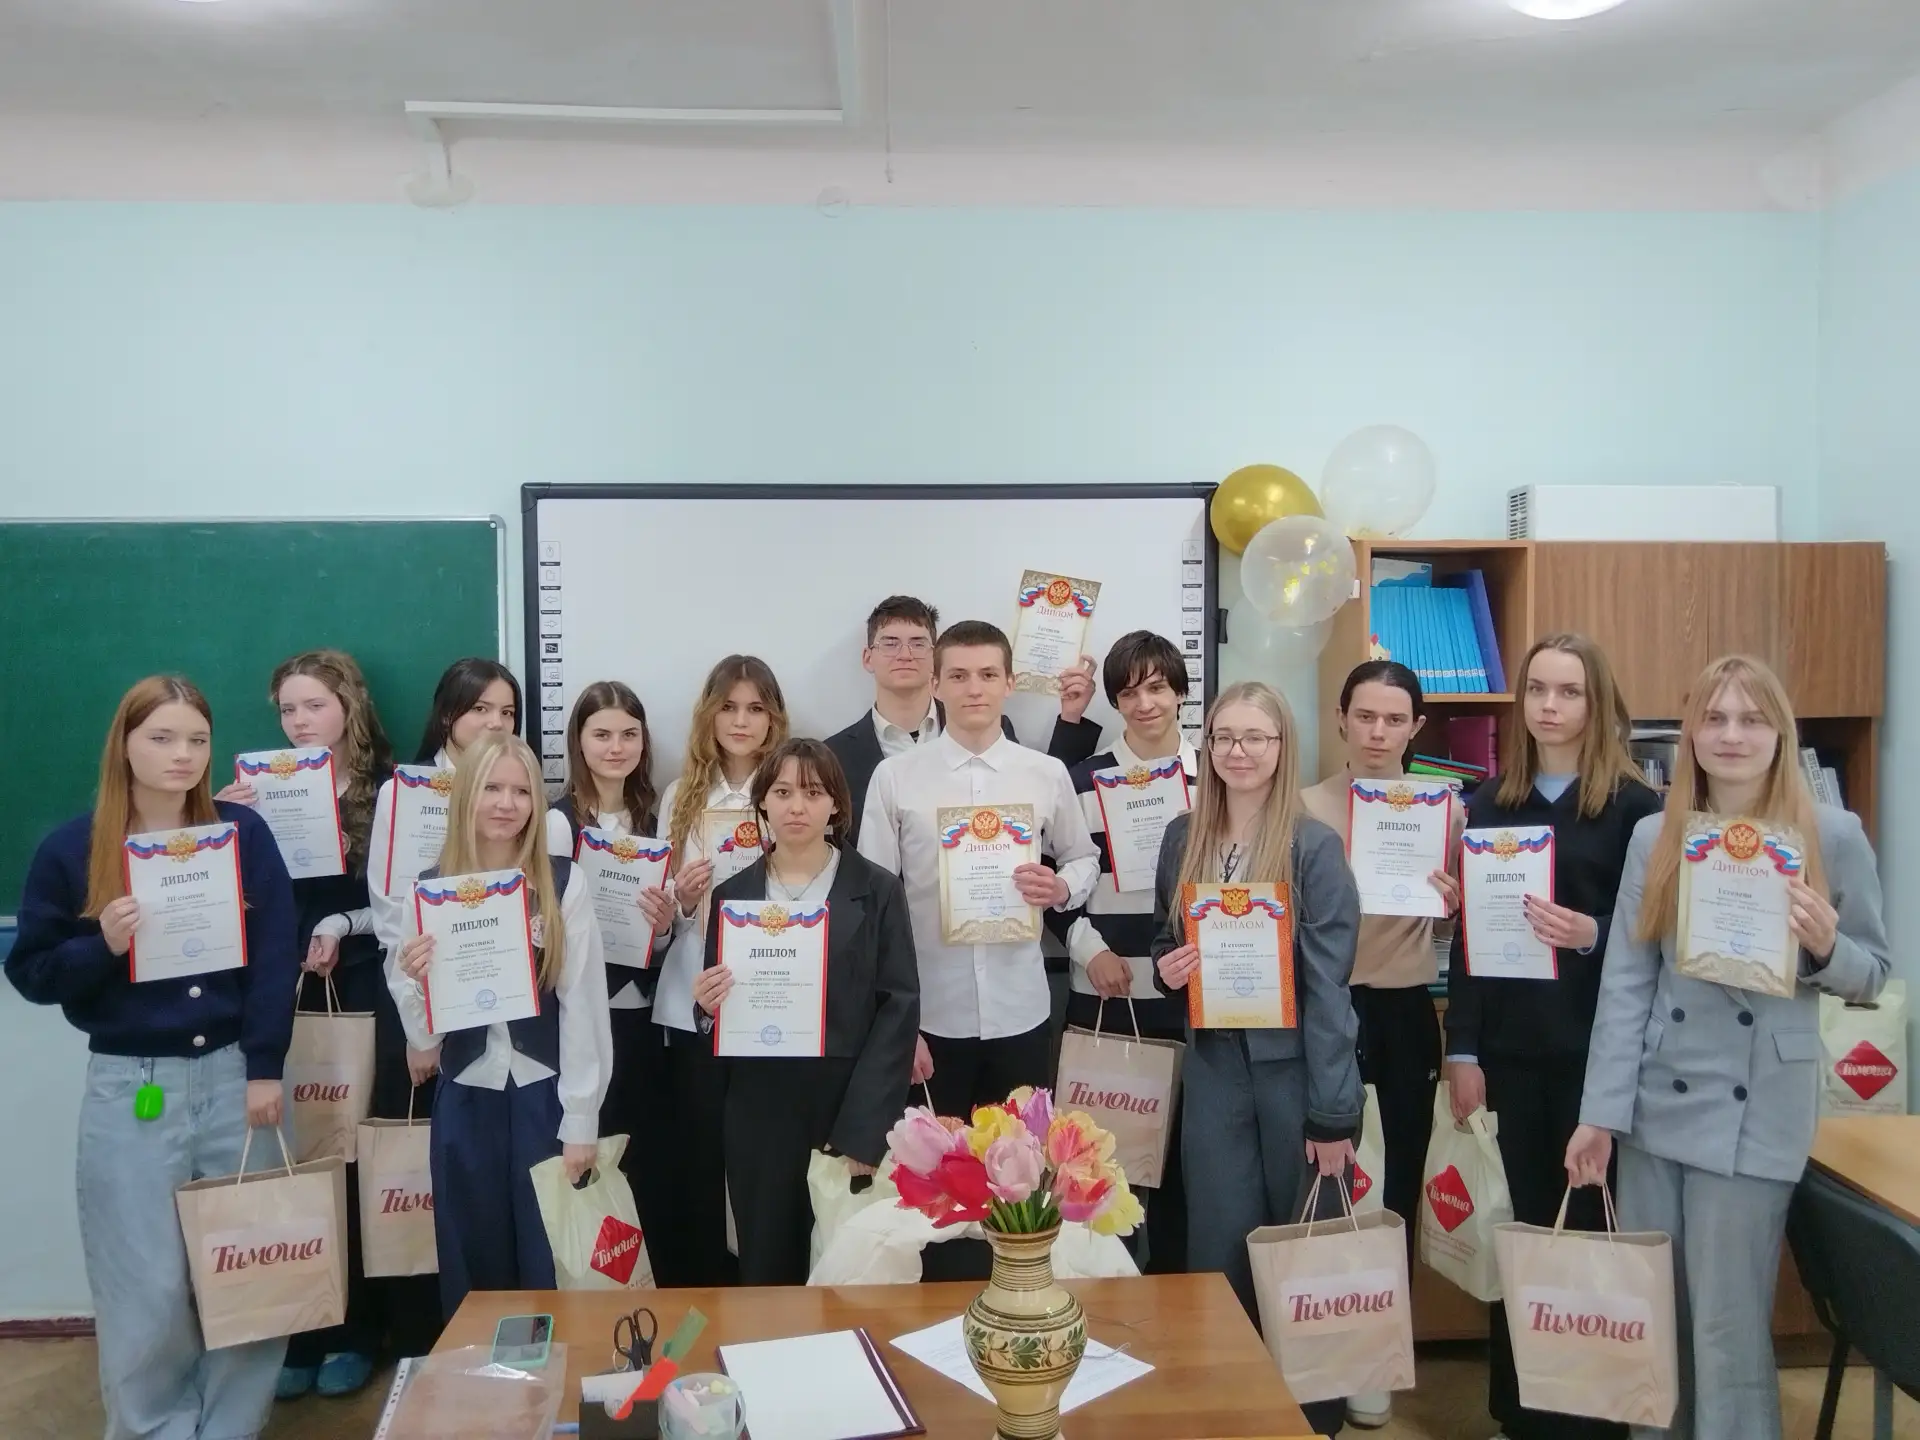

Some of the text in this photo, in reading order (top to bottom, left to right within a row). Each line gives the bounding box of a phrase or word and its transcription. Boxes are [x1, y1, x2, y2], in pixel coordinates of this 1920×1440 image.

[265, 788, 309, 801] ДИПЛОМ
[420, 805, 449, 816] ДИПЛ
[1126, 796, 1165, 811] ДИПЛОМ
[1376, 821, 1421, 832] ДИПЛОМ
[160, 870, 210, 888] ДИПЛОМ
[598, 868, 640, 885] ДИПЛОМ
[1485, 872, 1526, 884] ДИПЛОМ
[177, 892, 206, 901] степени
[450, 916, 499, 935] ДИПЛОМ
[1210, 920, 1265, 931] ДИПЛОМ
[458, 938, 495, 951] участника
[748, 948, 797, 959] ДИПЛОМ
[755, 969, 790, 977] участника
[1067, 1080, 1160, 1116] Тимоша
[1429, 1183, 1471, 1214] Тимоша
[211, 1236, 324, 1275] Тимоша
[594, 1233, 640, 1269] Тимоша
[1288, 1288, 1394, 1324] Тимоша
[1527, 1301, 1646, 1344] Тимоша
